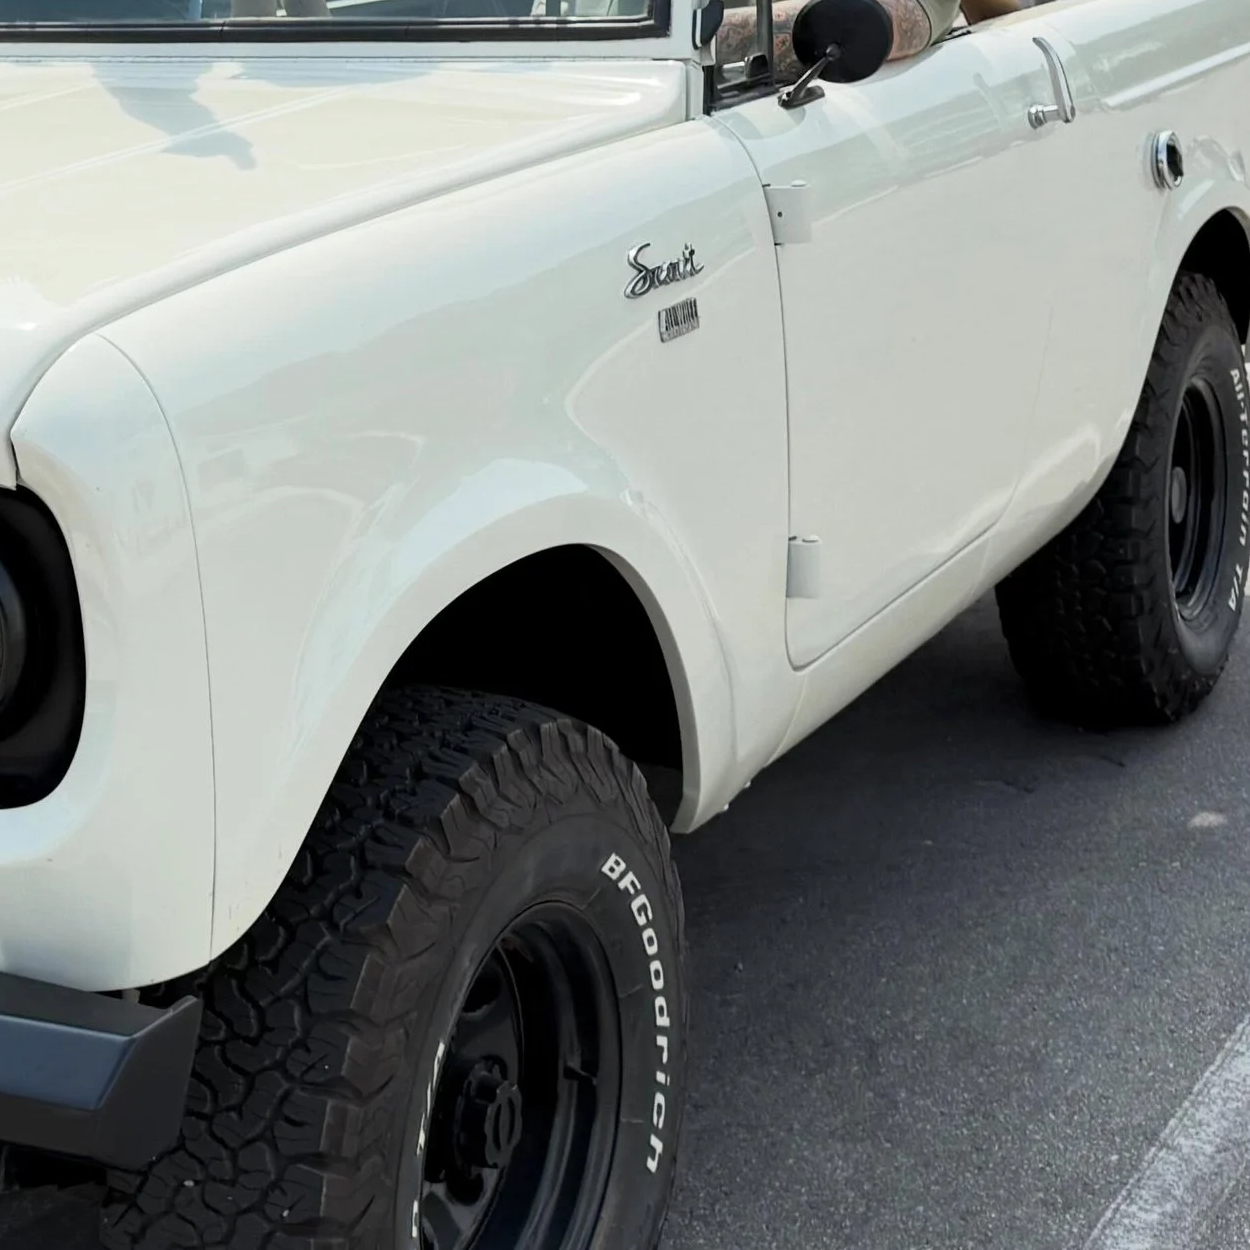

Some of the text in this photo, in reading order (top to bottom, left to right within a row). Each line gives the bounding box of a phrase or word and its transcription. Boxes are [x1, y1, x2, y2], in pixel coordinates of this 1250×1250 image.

[1228, 368, 1250, 612] All-Terrain T/A
[601, 852, 671, 1174] BFGoodrich
